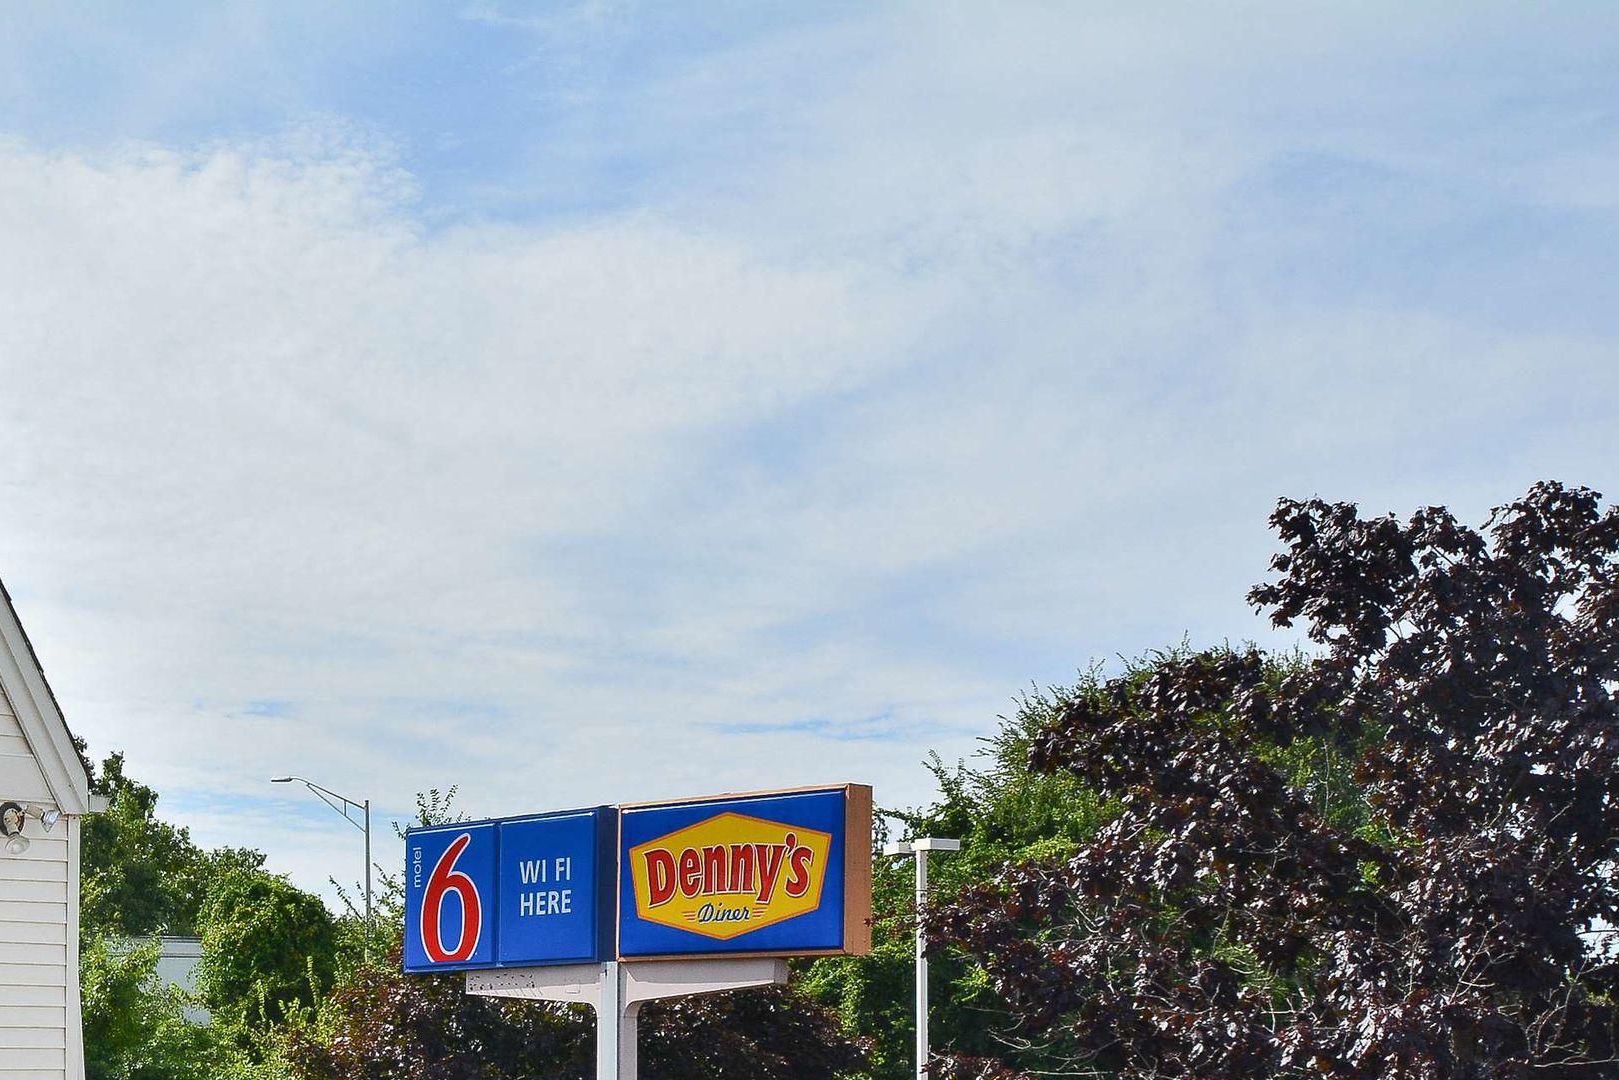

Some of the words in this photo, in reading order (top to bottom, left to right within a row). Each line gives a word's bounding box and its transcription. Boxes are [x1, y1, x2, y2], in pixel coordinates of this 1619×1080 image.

[412, 846, 423, 889] motel
[519, 859, 548, 885] WI
[555, 857, 572, 883] FI
[642, 831, 815, 909] Denny's
[420, 832, 482, 964] 6
[519, 890, 572, 917] HERE
[697, 901, 751, 924] Diner
